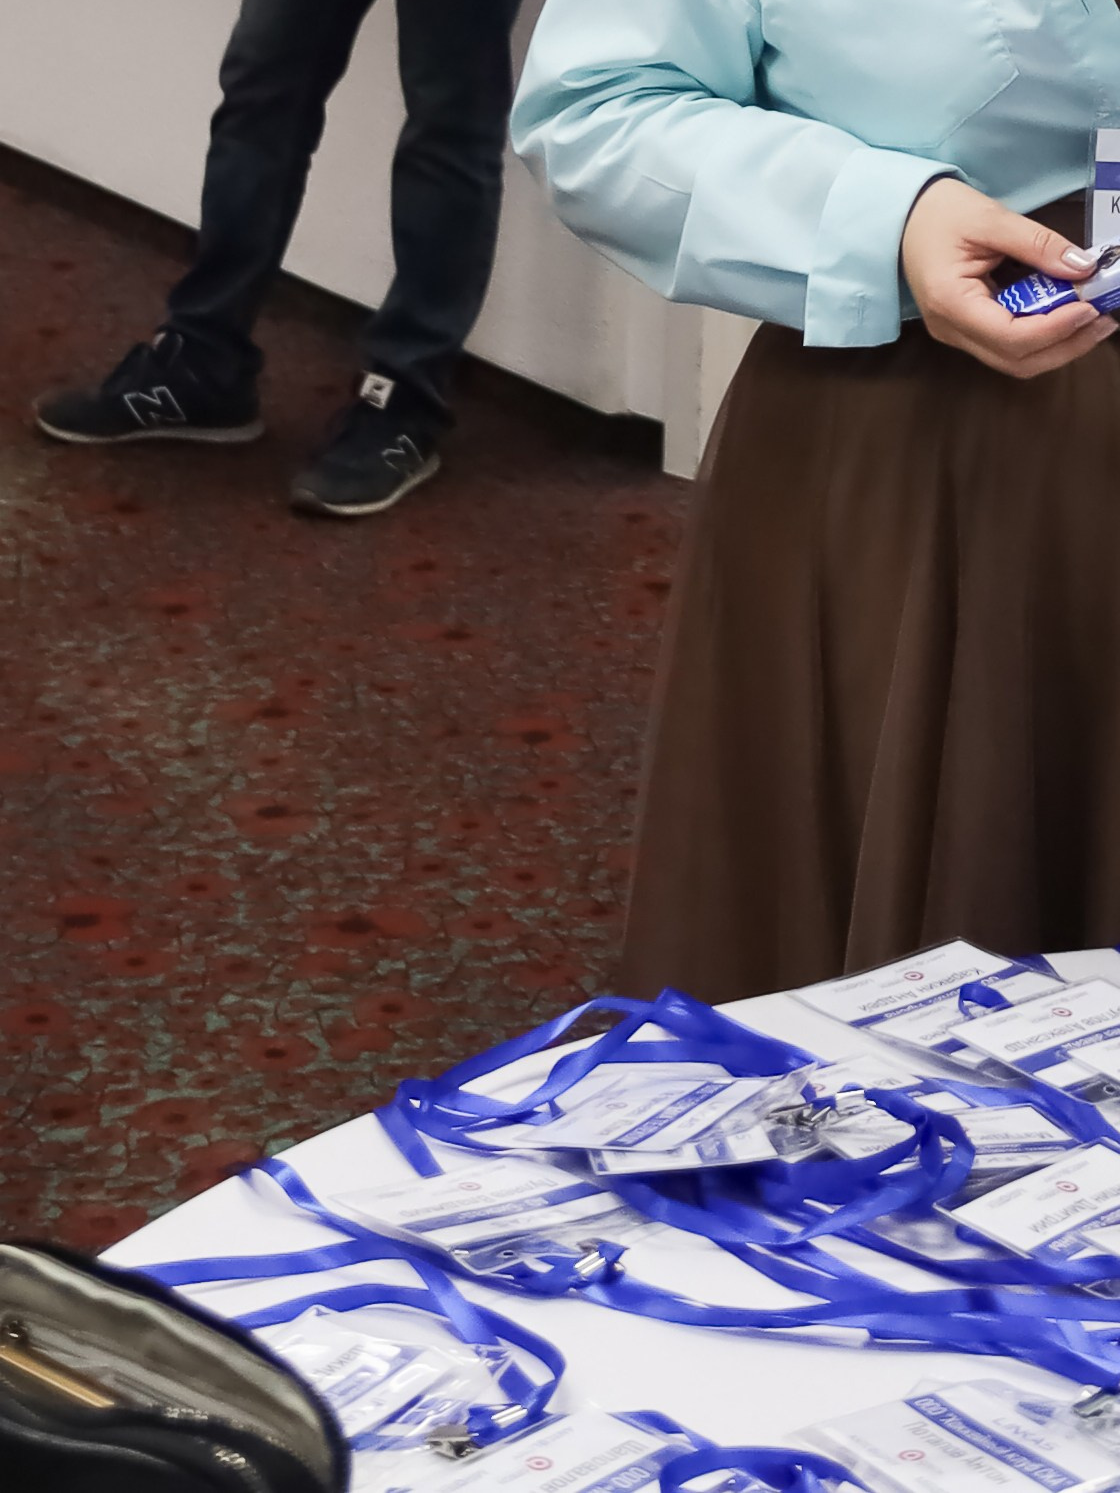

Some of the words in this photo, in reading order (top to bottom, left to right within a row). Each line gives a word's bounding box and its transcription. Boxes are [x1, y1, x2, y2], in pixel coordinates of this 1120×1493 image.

[854, 988, 921, 1014] Андрей
[1000, 1021, 1089, 1054] Александр
[394, 1192, 498, 1220] Владимир
[1023, 1197, 1101, 1237] Дмитрий
[911, 1397, 949, 1416] ООО
[535, 1433, 648, 1493] Шаповалов
[900, 1419, 973, 1460] Потапов
[958, 1452, 1017, 1486] Антон
